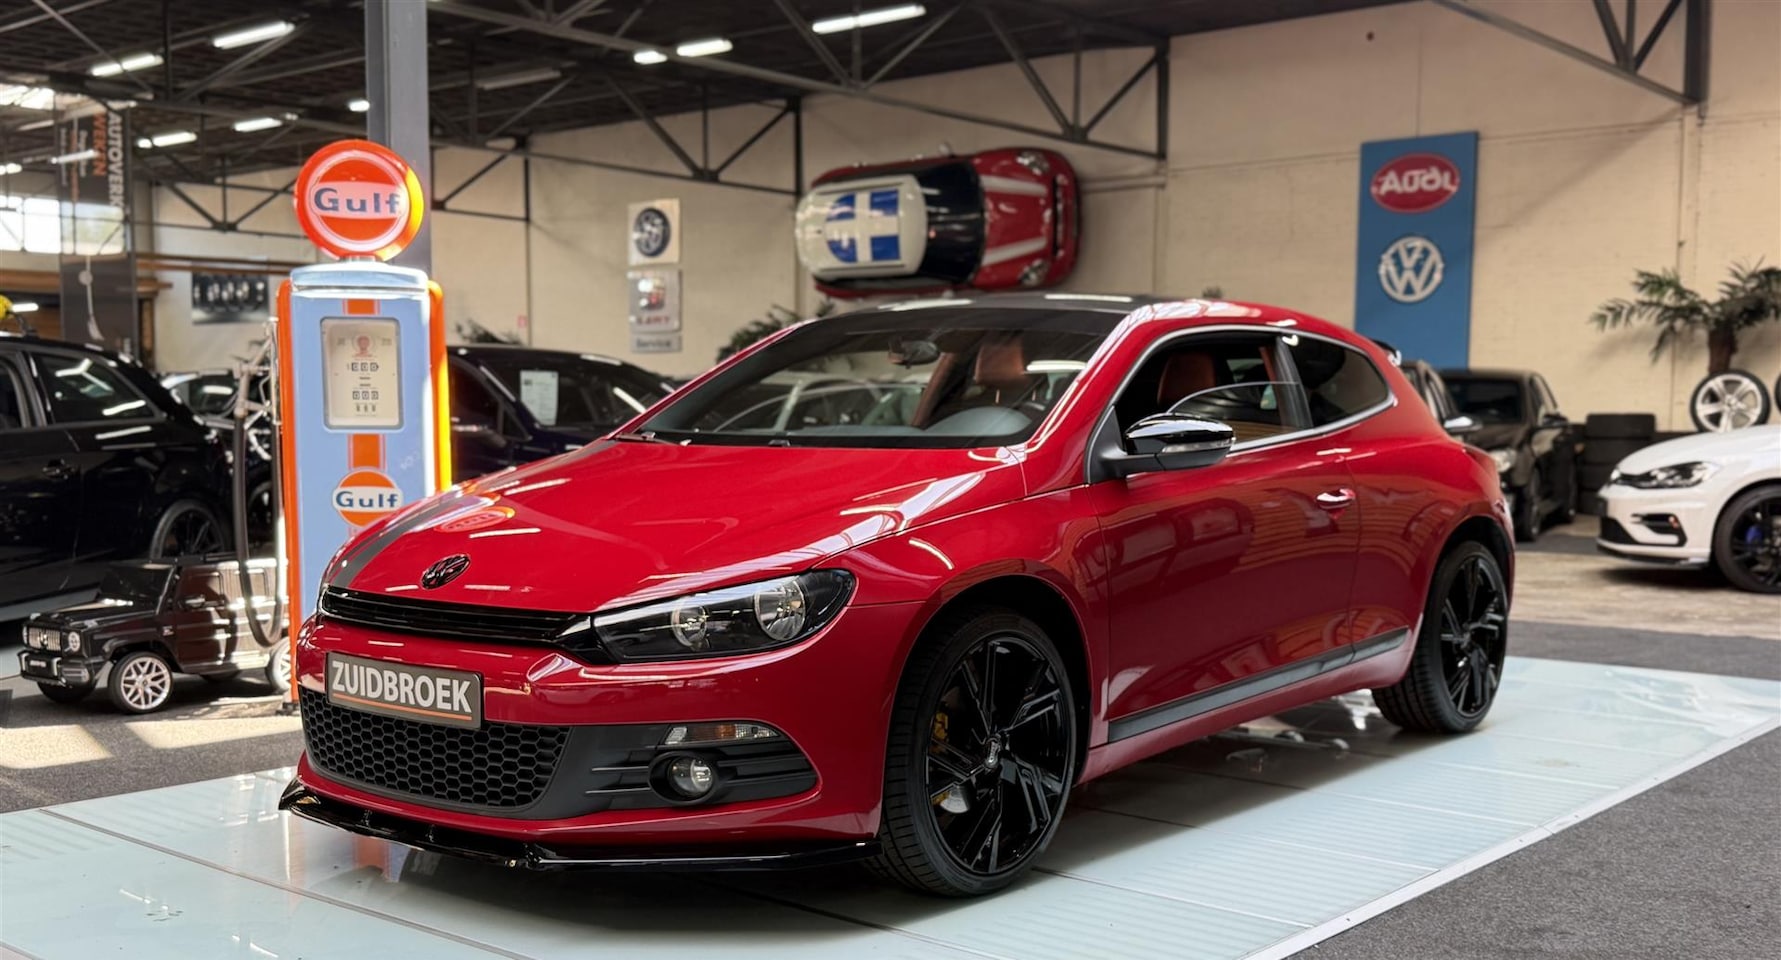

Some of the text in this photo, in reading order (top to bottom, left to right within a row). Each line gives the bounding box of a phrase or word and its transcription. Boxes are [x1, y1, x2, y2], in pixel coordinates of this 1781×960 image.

[313, 187, 400, 214] Gulf
[335, 490, 399, 508] Gulf
[332, 660, 472, 713] ZUIDBROEK
